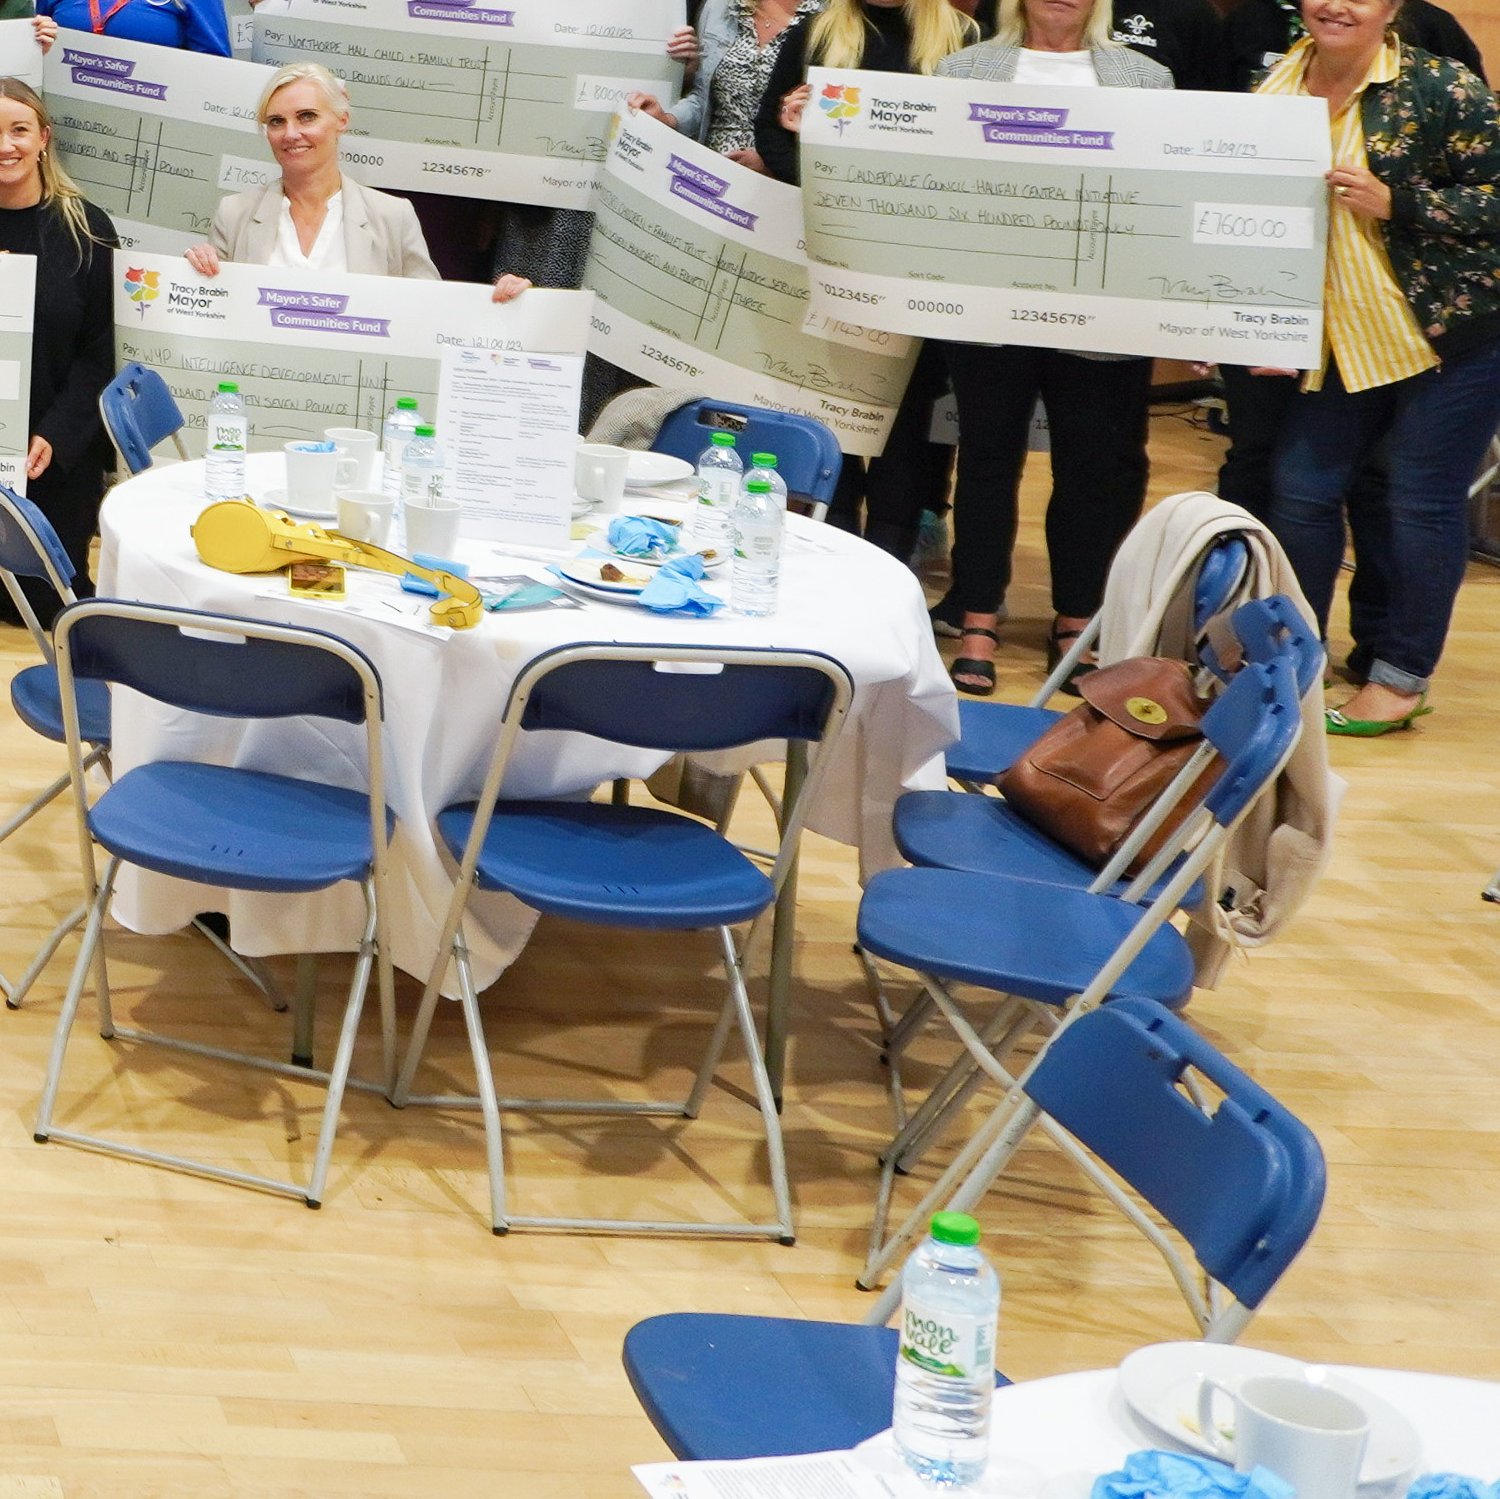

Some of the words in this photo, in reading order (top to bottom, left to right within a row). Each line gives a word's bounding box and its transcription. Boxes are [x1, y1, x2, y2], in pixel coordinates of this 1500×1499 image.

[413, 6, 479, 21] Communities
[481, 11, 507, 24] Fund
[1112, 31, 1157, 48] Scouts
[104, 59, 128, 73] Safer
[76, 73, 133, 91] Communities
[136, 80, 160, 94] Fund
[871, 97, 899, 113] Tracy
[902, 100, 937, 113] Brabin
[870, 107, 918, 126] Mayor
[977, 107, 1025, 124] Mayor's
[1028, 109, 1061, 124] Safer
[989, 128, 1070, 146] Communities
[1072, 133, 1104, 147] Fund
[1163, 142, 1193, 156] Date:
[168, 293, 213, 310] Mayor
[265, 291, 308, 307] Mayor's
[310, 295, 342, 308] Safer
[907, 299, 964, 316] 000000
[276, 312, 350, 329] Communities
[352, 319, 381, 333] Fund
